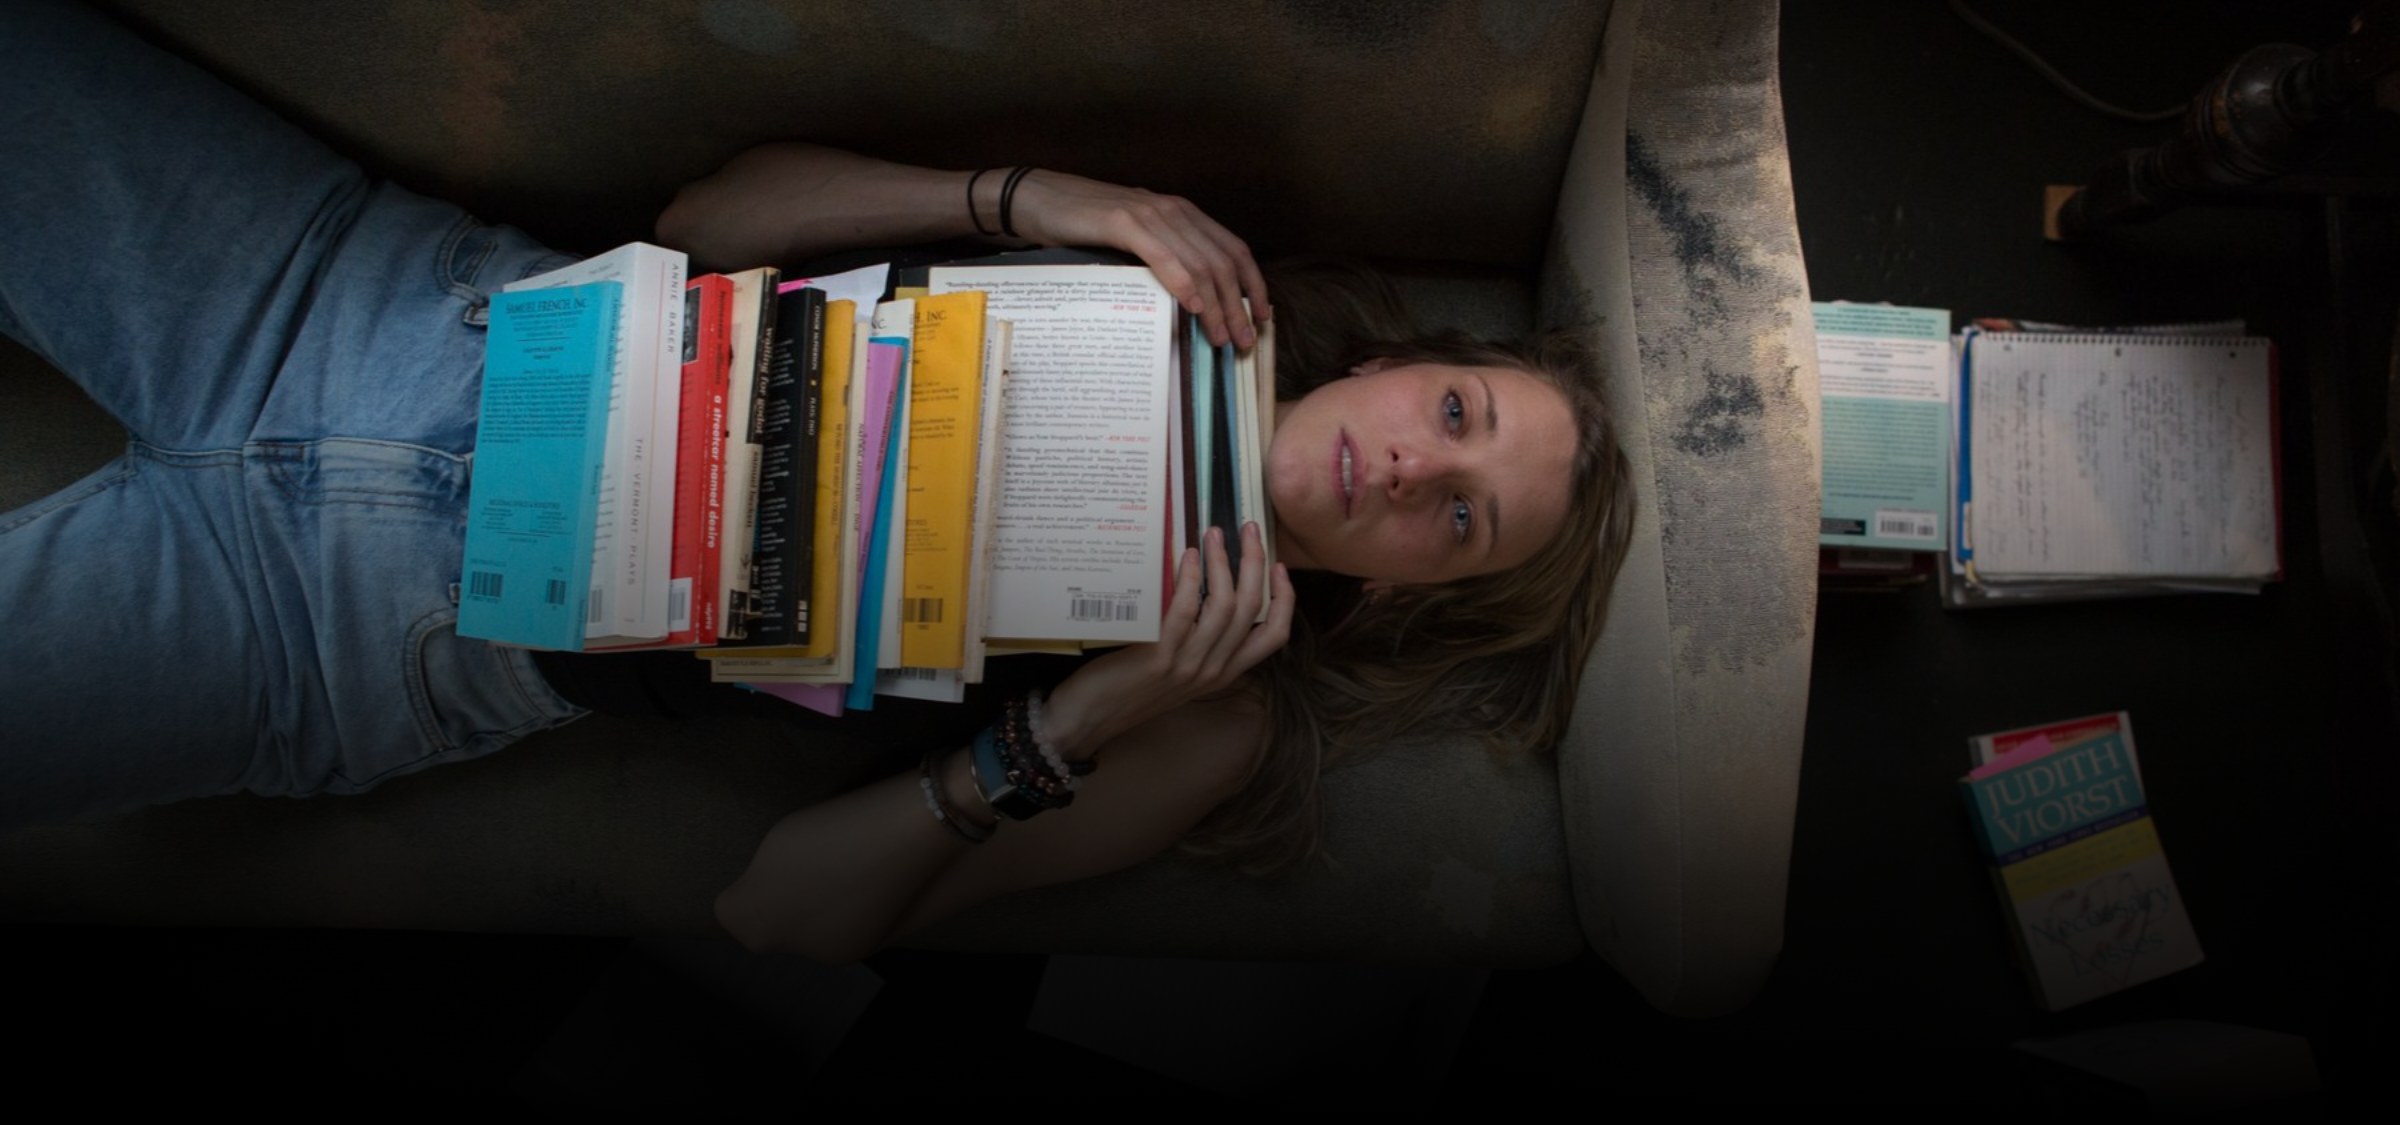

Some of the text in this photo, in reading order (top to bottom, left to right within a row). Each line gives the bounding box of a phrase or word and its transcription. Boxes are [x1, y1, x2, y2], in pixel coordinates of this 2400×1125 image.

[667, 264, 680, 354] ANNIE BAKER
[813, 304, 821, 330] CONOR
[755, 327, 773, 434] waiting for godot
[708, 394, 722, 548] a streetcar named desire
[746, 450, 760, 528] samuel beckett
[628, 438, 643, 585] THE VERMONT PLAYS
[1984, 741, 2122, 816] JUDITH
[1990, 774, 2130, 844] VIORST
[2031, 884, 2171, 947] Necessary
[2069, 932, 2164, 977] Losses
